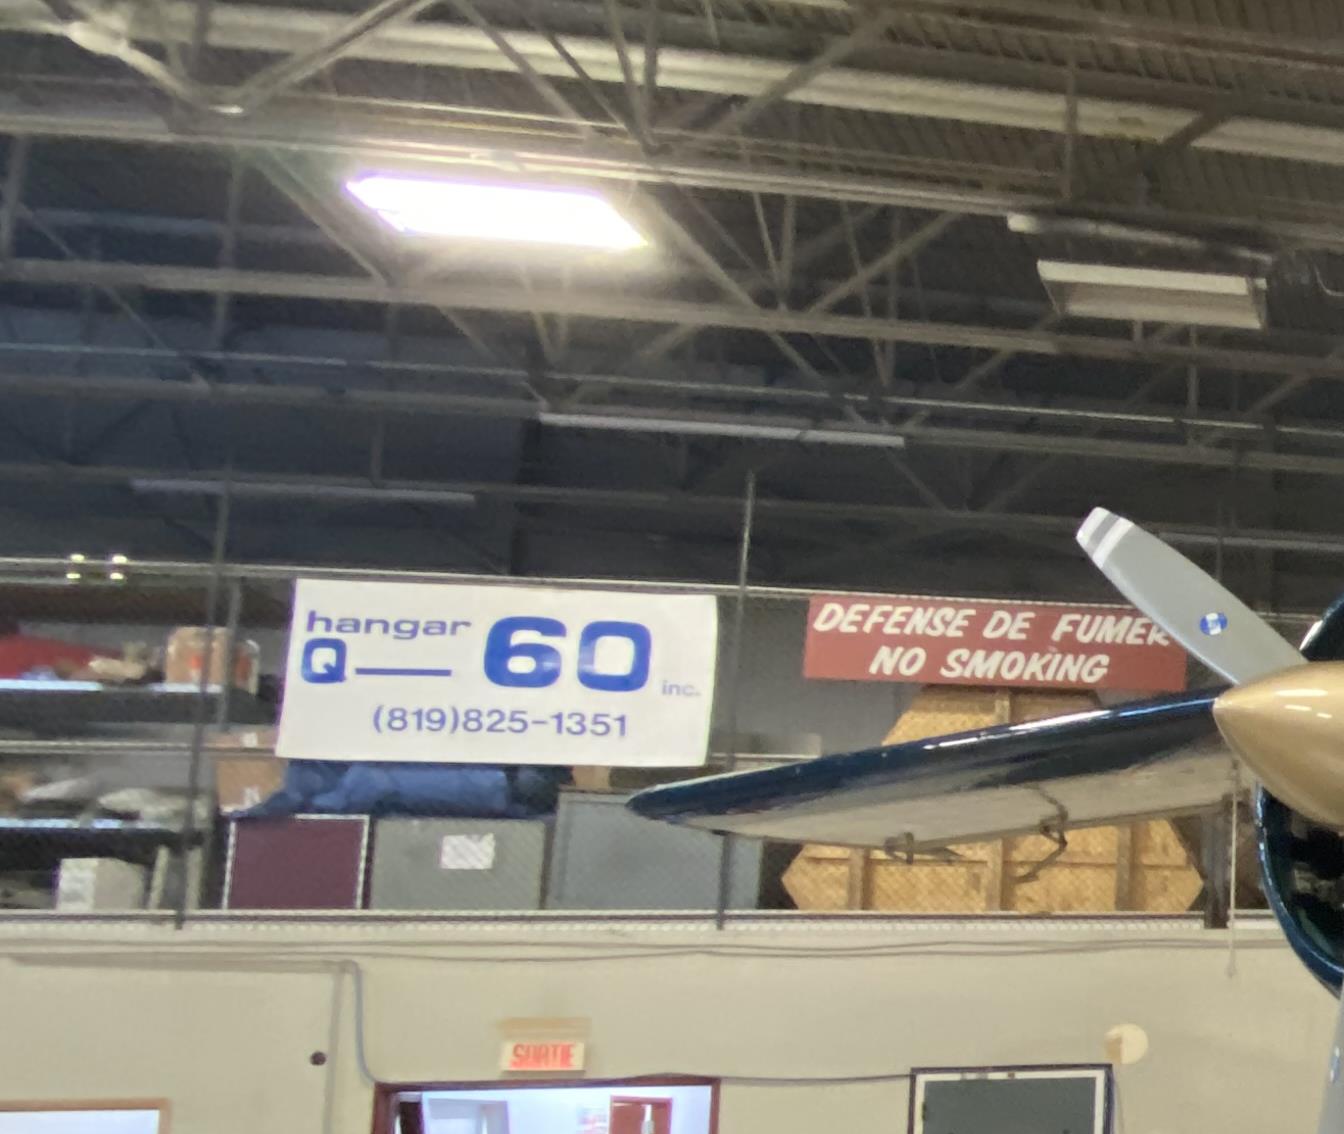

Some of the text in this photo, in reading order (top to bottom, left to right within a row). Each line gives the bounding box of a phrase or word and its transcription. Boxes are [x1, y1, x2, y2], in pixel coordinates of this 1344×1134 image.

[306, 610, 472, 640] hangar
[813, 602, 977, 638] DEFENSE
[982, 610, 1035, 640] DE
[868, 645, 1111, 684] NO SMOKING
[661, 679, 702, 697] inc.
[371, 705, 628, 738] (819)825-1351
